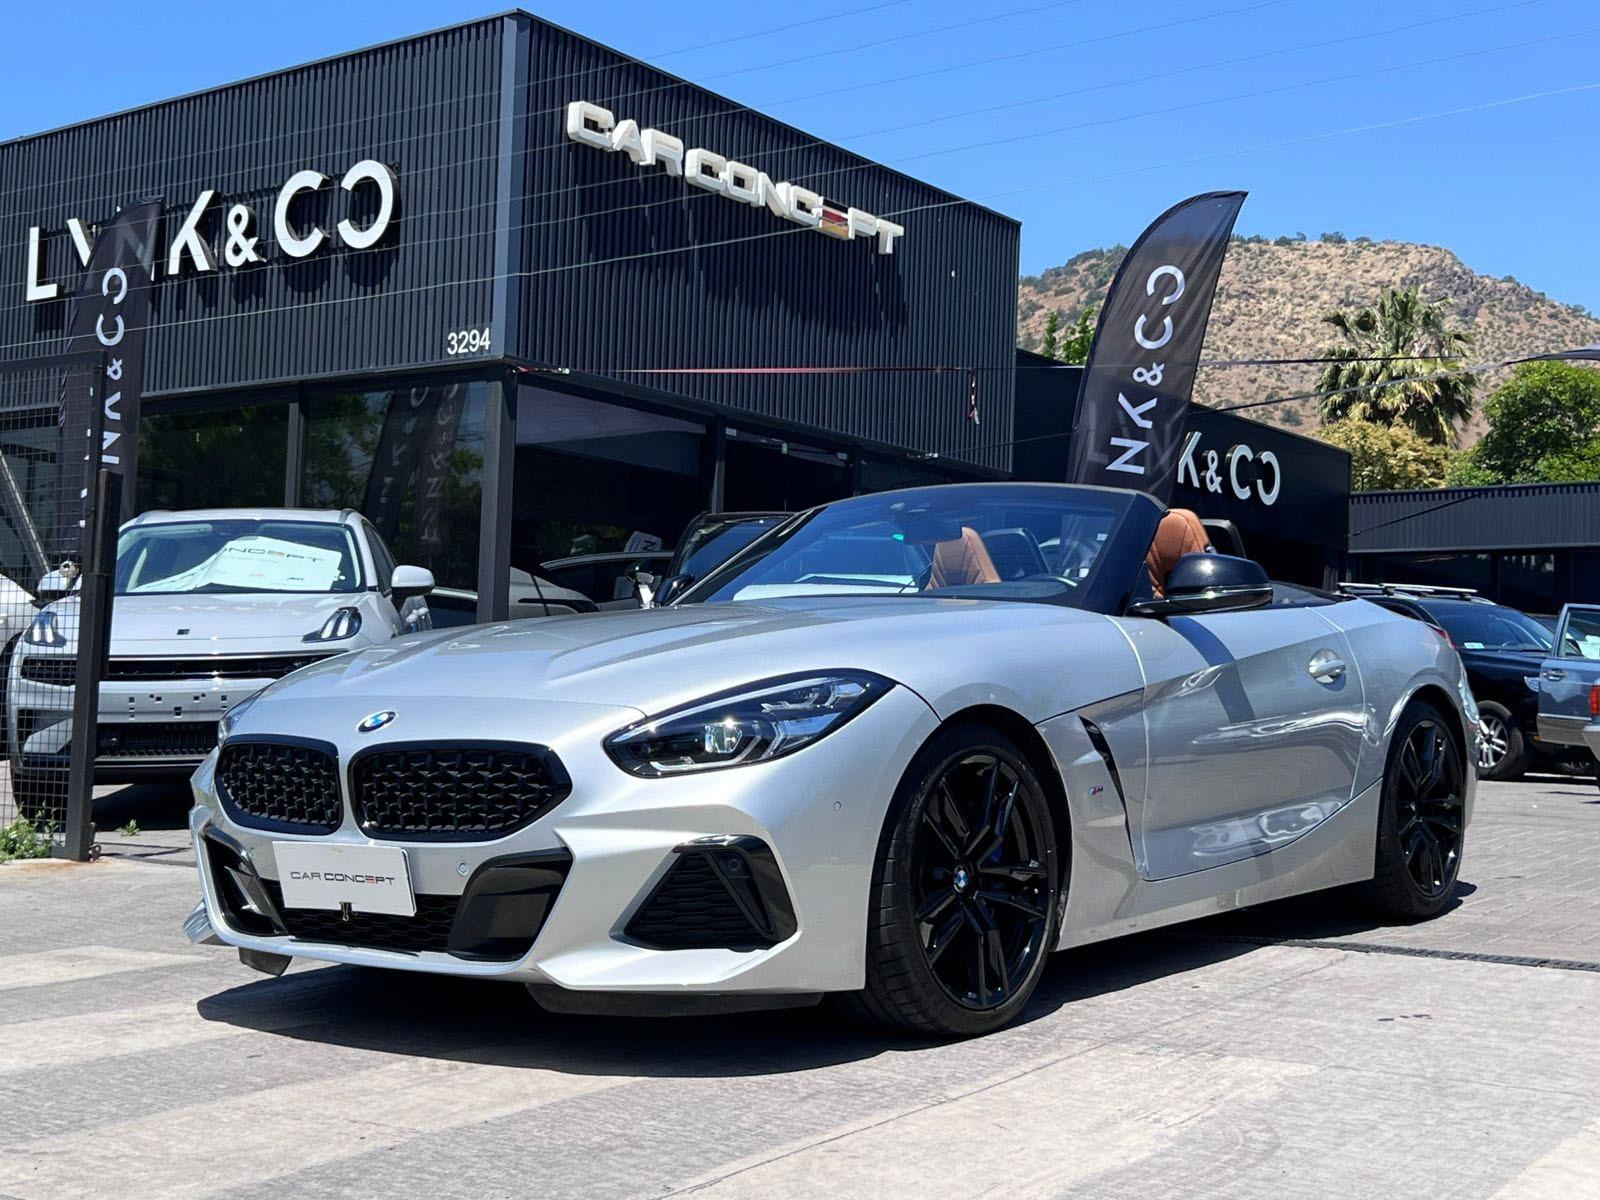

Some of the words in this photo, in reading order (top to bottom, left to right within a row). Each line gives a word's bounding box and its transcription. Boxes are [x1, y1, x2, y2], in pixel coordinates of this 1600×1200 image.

[567, 101, 684, 177] CAR
[685, 147, 904, 255] CONCEPT
[447, 327, 491, 355] 3294
[290, 871, 322, 881] CAR
[323, 872, 395, 886] CONCEPT
